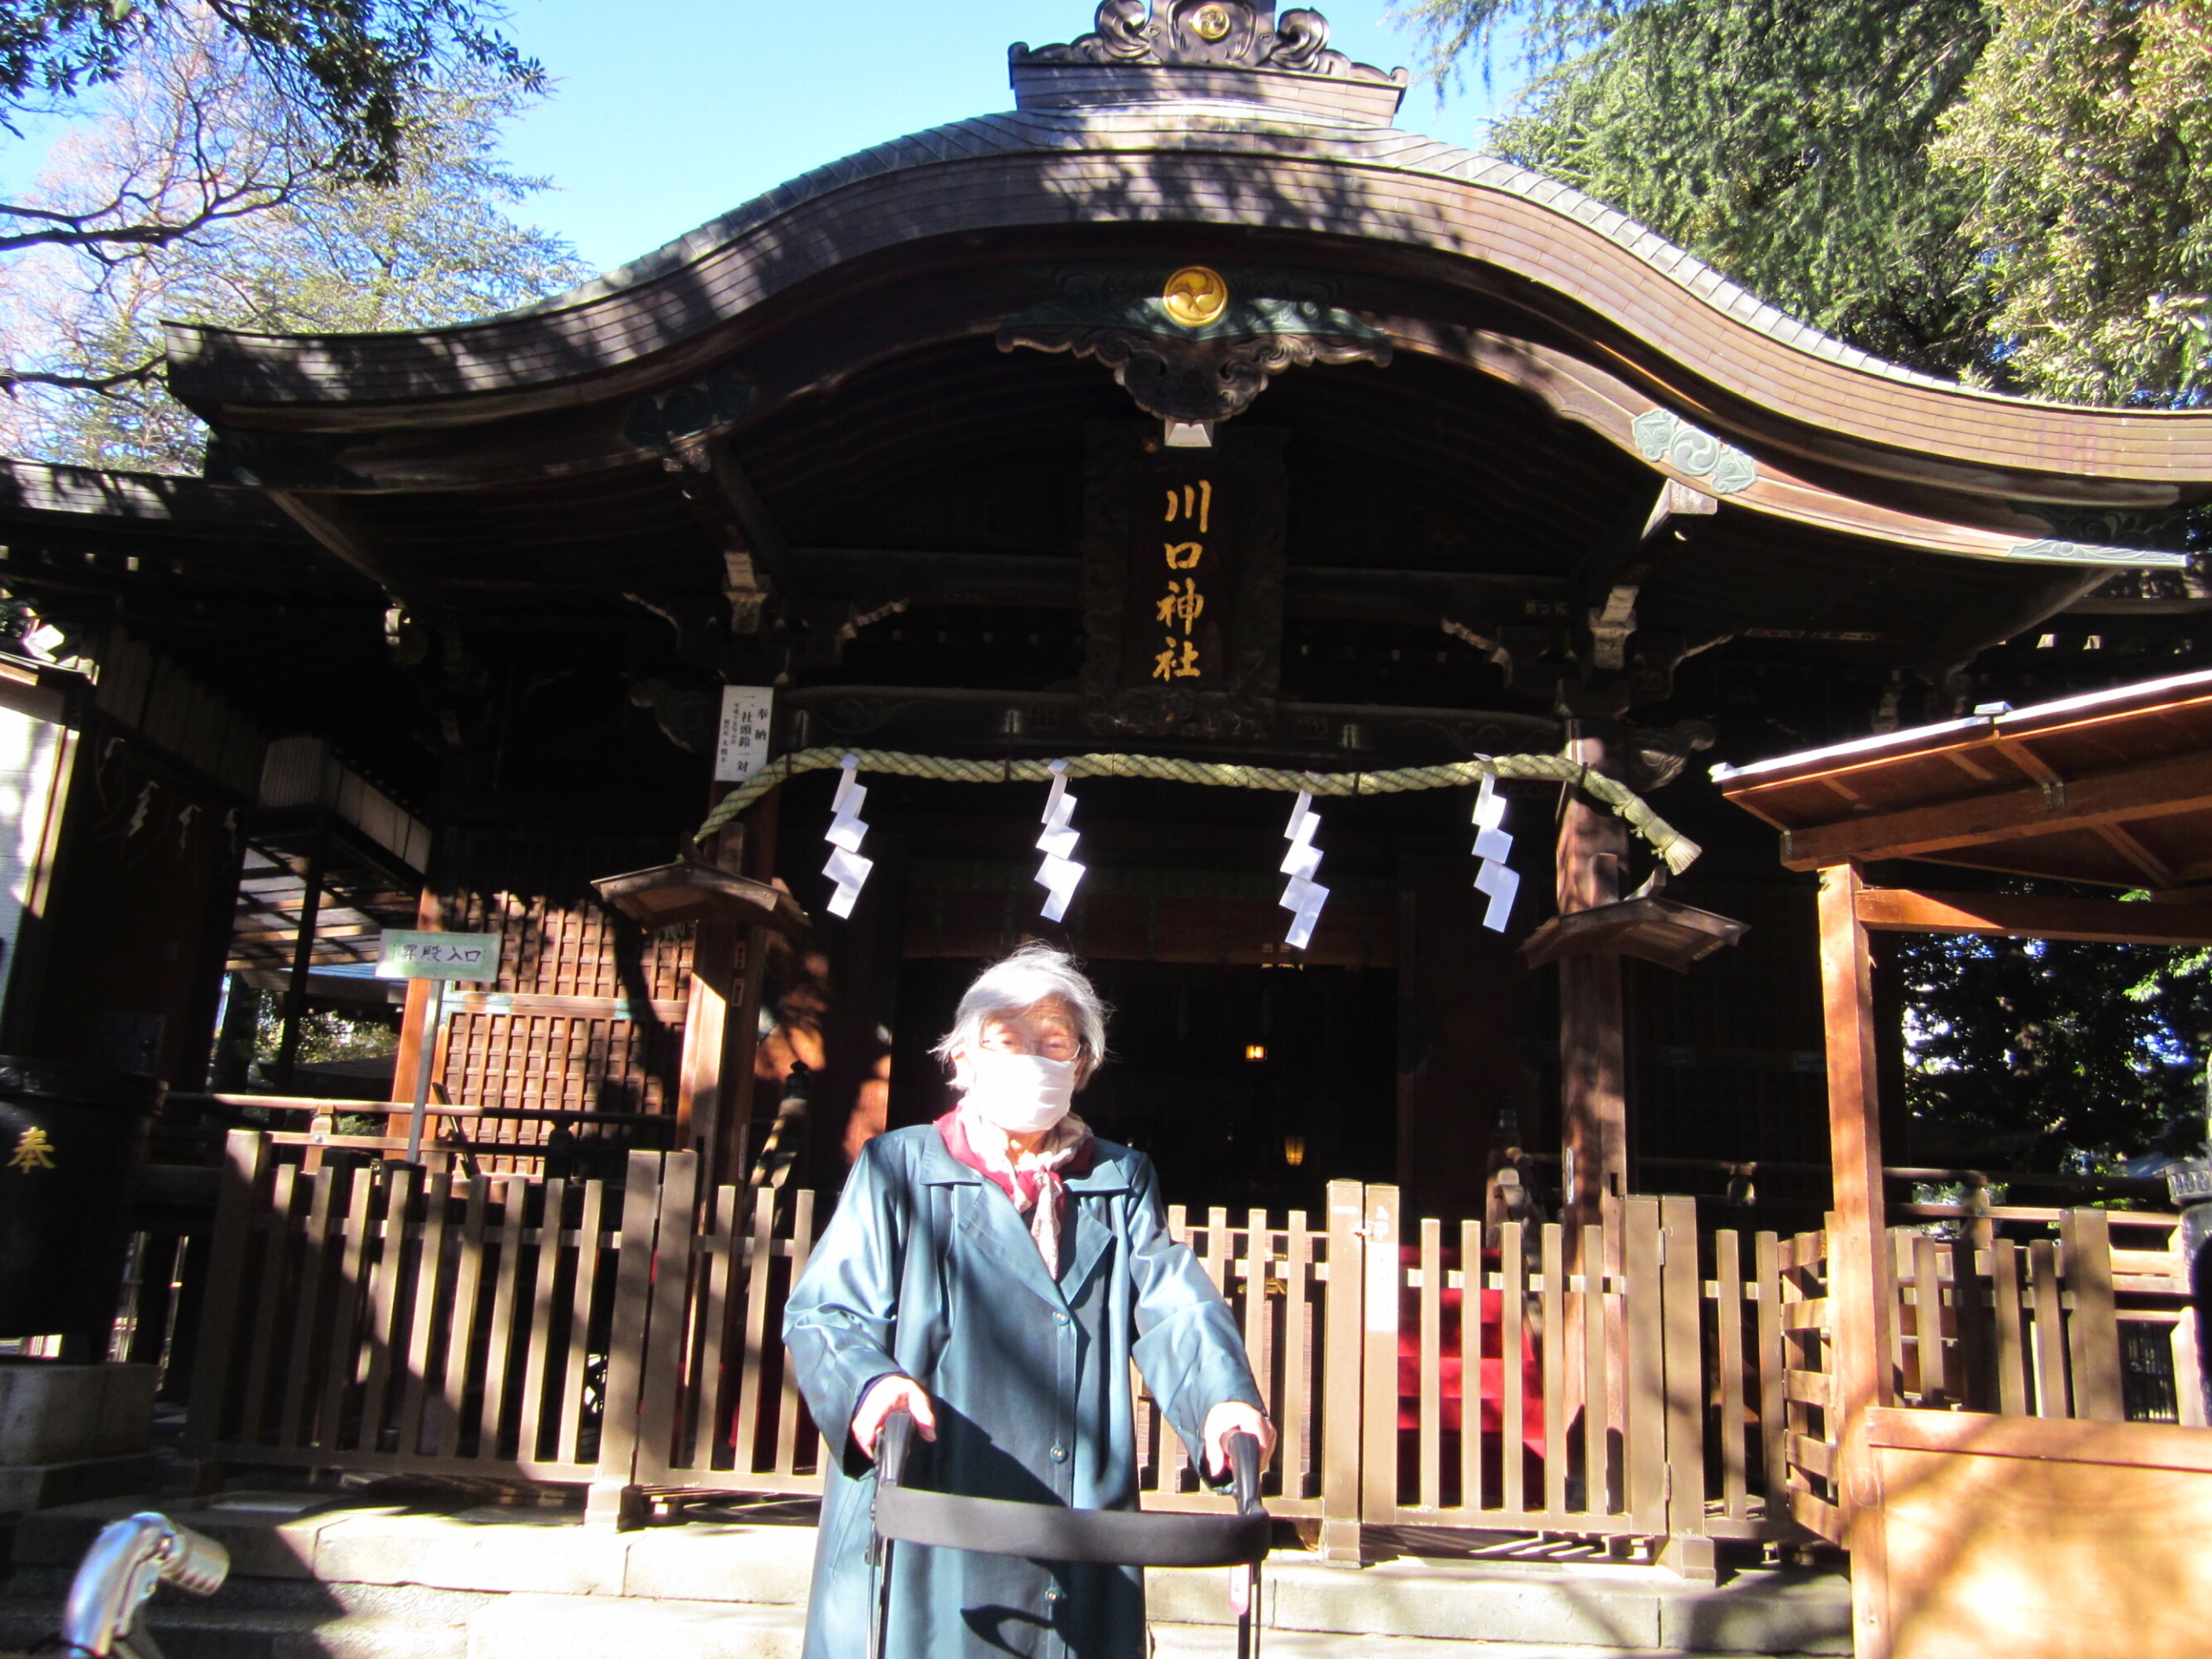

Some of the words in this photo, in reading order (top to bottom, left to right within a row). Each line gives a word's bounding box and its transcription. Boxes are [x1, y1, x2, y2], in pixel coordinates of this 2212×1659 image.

[1153, 480, 1211, 682] 川口神社
[754, 708, 768, 741] 奉納
[400, 944, 481, 963] 昇殿入口
[7, 1126, 57, 1174] 奉
